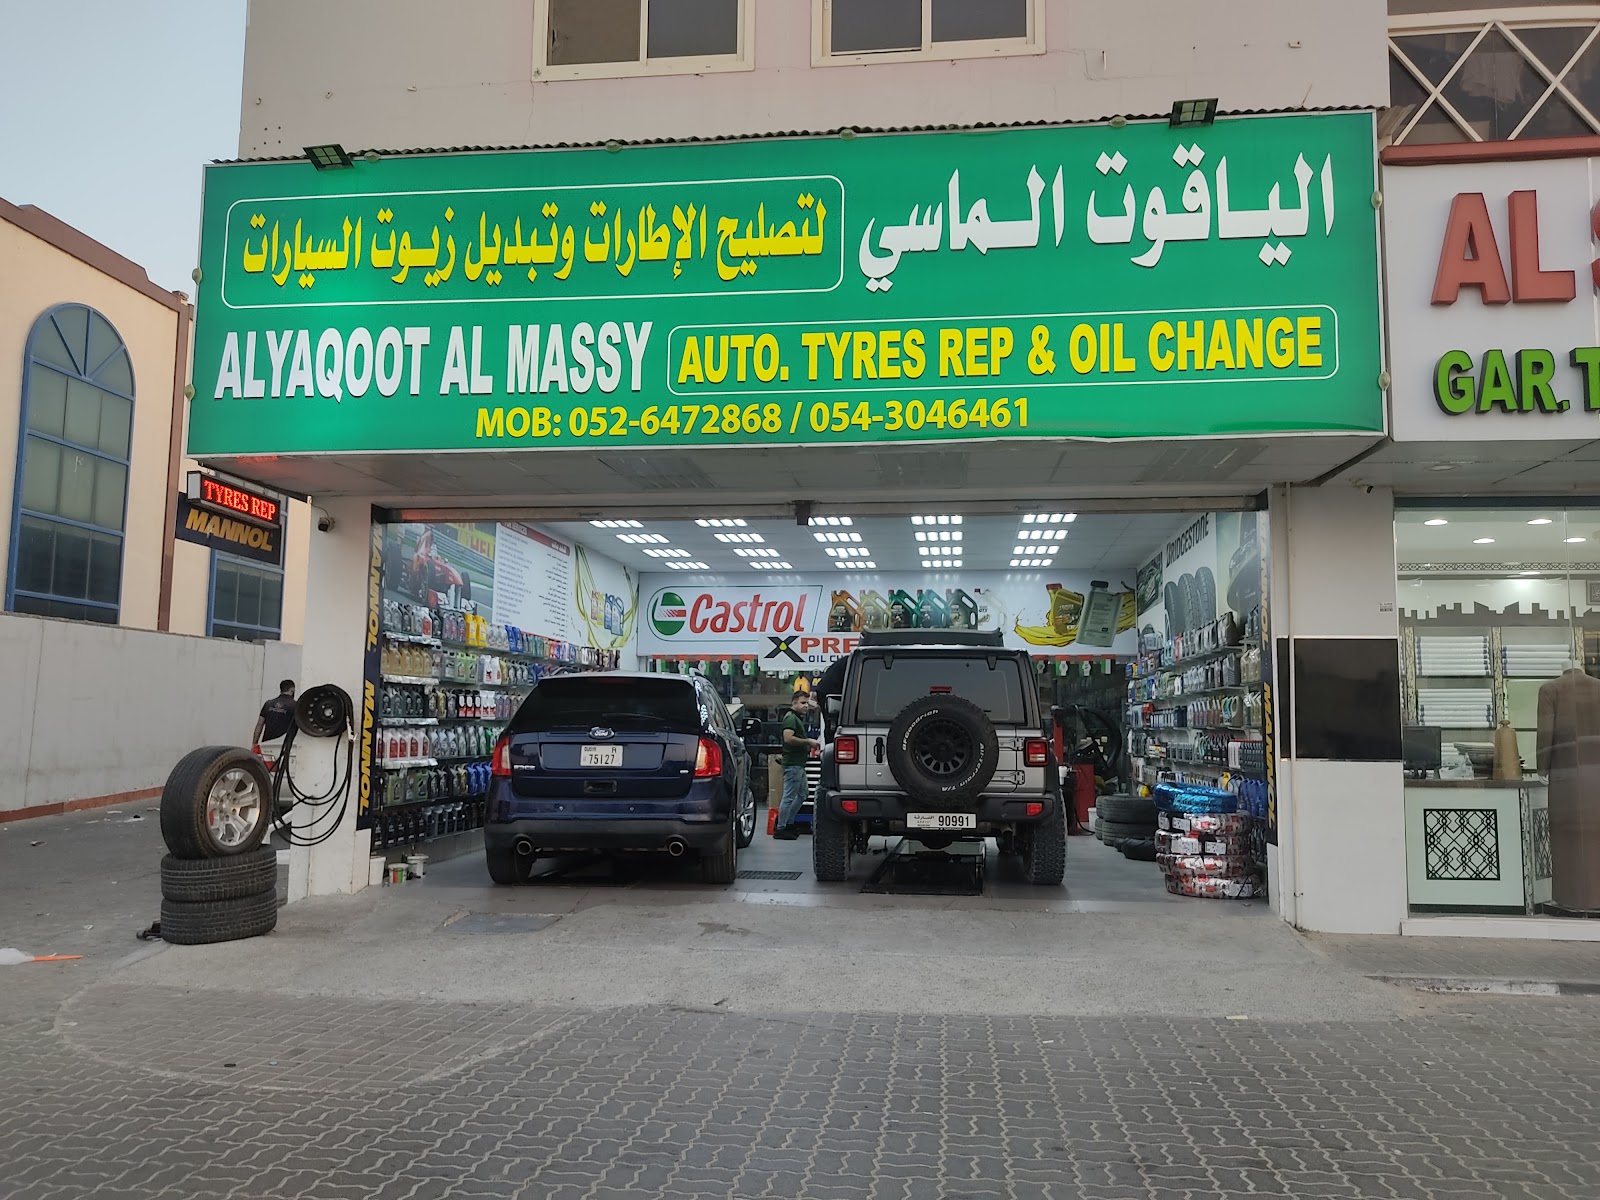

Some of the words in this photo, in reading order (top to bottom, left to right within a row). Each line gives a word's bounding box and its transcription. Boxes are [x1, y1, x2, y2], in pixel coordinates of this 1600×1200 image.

[584, 201, 707, 279] الإطارات
[717, 194, 827, 281] لتصليح
[858, 164, 1065, 292] الماسي
[1087, 143, 1335, 267] الياقوت
[243, 214, 362, 288] السيارات
[370, 207, 456, 287] زيوت
[464, 203, 575, 285] وتبديل
[1431, 190, 1576, 305] AL
[214, 325, 431, 403] ALYAQOOT
[439, 325, 493, 395] AL
[506, 321, 653, 394] MASSY
[677, 333, 789, 384] AUTO.
[801, 330, 926, 381] TYRES
[939, 327, 1014, 377] REP
[1027, 325, 1056, 375] &
[1069, 323, 1136, 374] OIL
[1148, 316, 1323, 373] CHANGE
[476, 407, 562, 438] MOB:
[569, 403, 782, 437] 052-6472868
[789, 401, 803, 434] /
[809, 398, 1028, 432] 054-3046461
[185, 508, 273, 552] MANNOL
[203, 480, 249, 512] TYRES
[250, 496, 276, 521] REP
[1165, 512, 1209, 568] BRIDGESTONE
[367, 520, 382, 652] MANNOL
[689, 594, 807, 633] Castrol
[763, 636, 859, 662] XPRE
[808, 655, 826, 663] OIL
[359, 679, 375, 816] MANNOL
[588, 754, 615, 765] 75127
[1263, 681, 1275, 829] MANNOL
[938, 815, 969, 827] 90991
